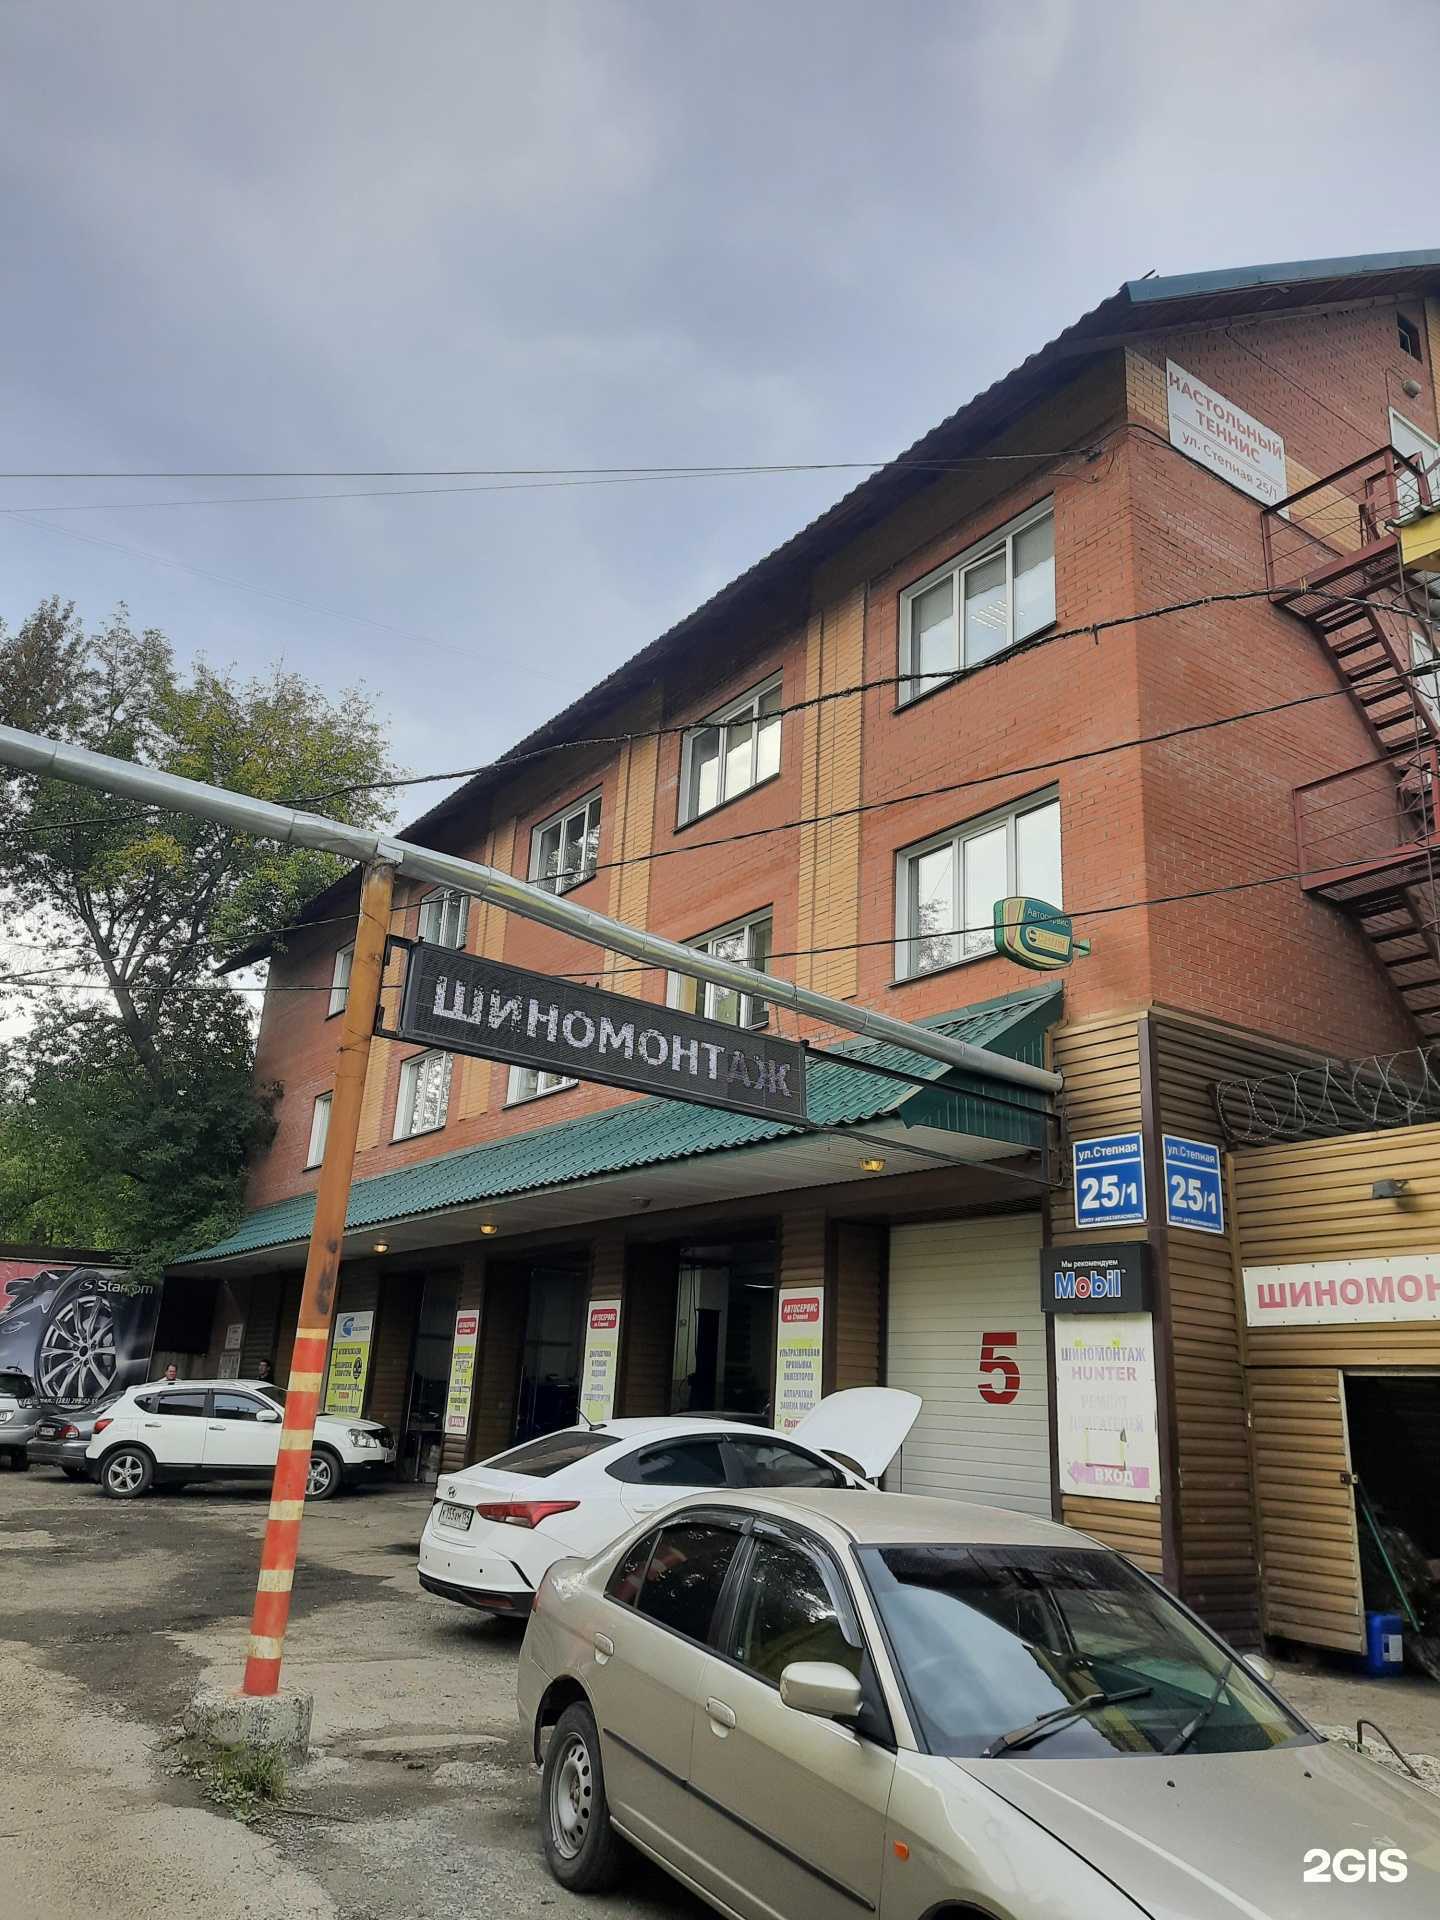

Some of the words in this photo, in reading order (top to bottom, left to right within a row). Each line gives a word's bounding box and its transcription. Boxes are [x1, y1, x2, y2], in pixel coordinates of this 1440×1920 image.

[1168, 371, 1282, 460] НАСТОЛЬНЫЙ
[1196, 409, 1260, 463] ТЕННИС
[1182, 432, 1201, 450] ул.
[1204, 444, 1253, 482] Степная
[1256, 477, 1278, 500] 25/1
[433, 976, 793, 1098] ШИНОМОНТАЖ
[1081, 1174, 1138, 1210] 25/1
[1171, 1174, 1217, 1215] 25/1
[1061, 1260, 1072, 1268] Мы
[1073, 1259, 1118, 1269] рекомендуем
[1054, 1269, 1121, 1299] Mobil
[783, 1303, 817, 1313] АВТОСЕРВИС
[978, 1331, 1020, 1405] 5
[1061, 1347, 1146, 1361] ШИНОМОНТАЖ
[1071, 1366, 1137, 1381] HUNTER
[1095, 1468, 1135, 1487] ВХОД
